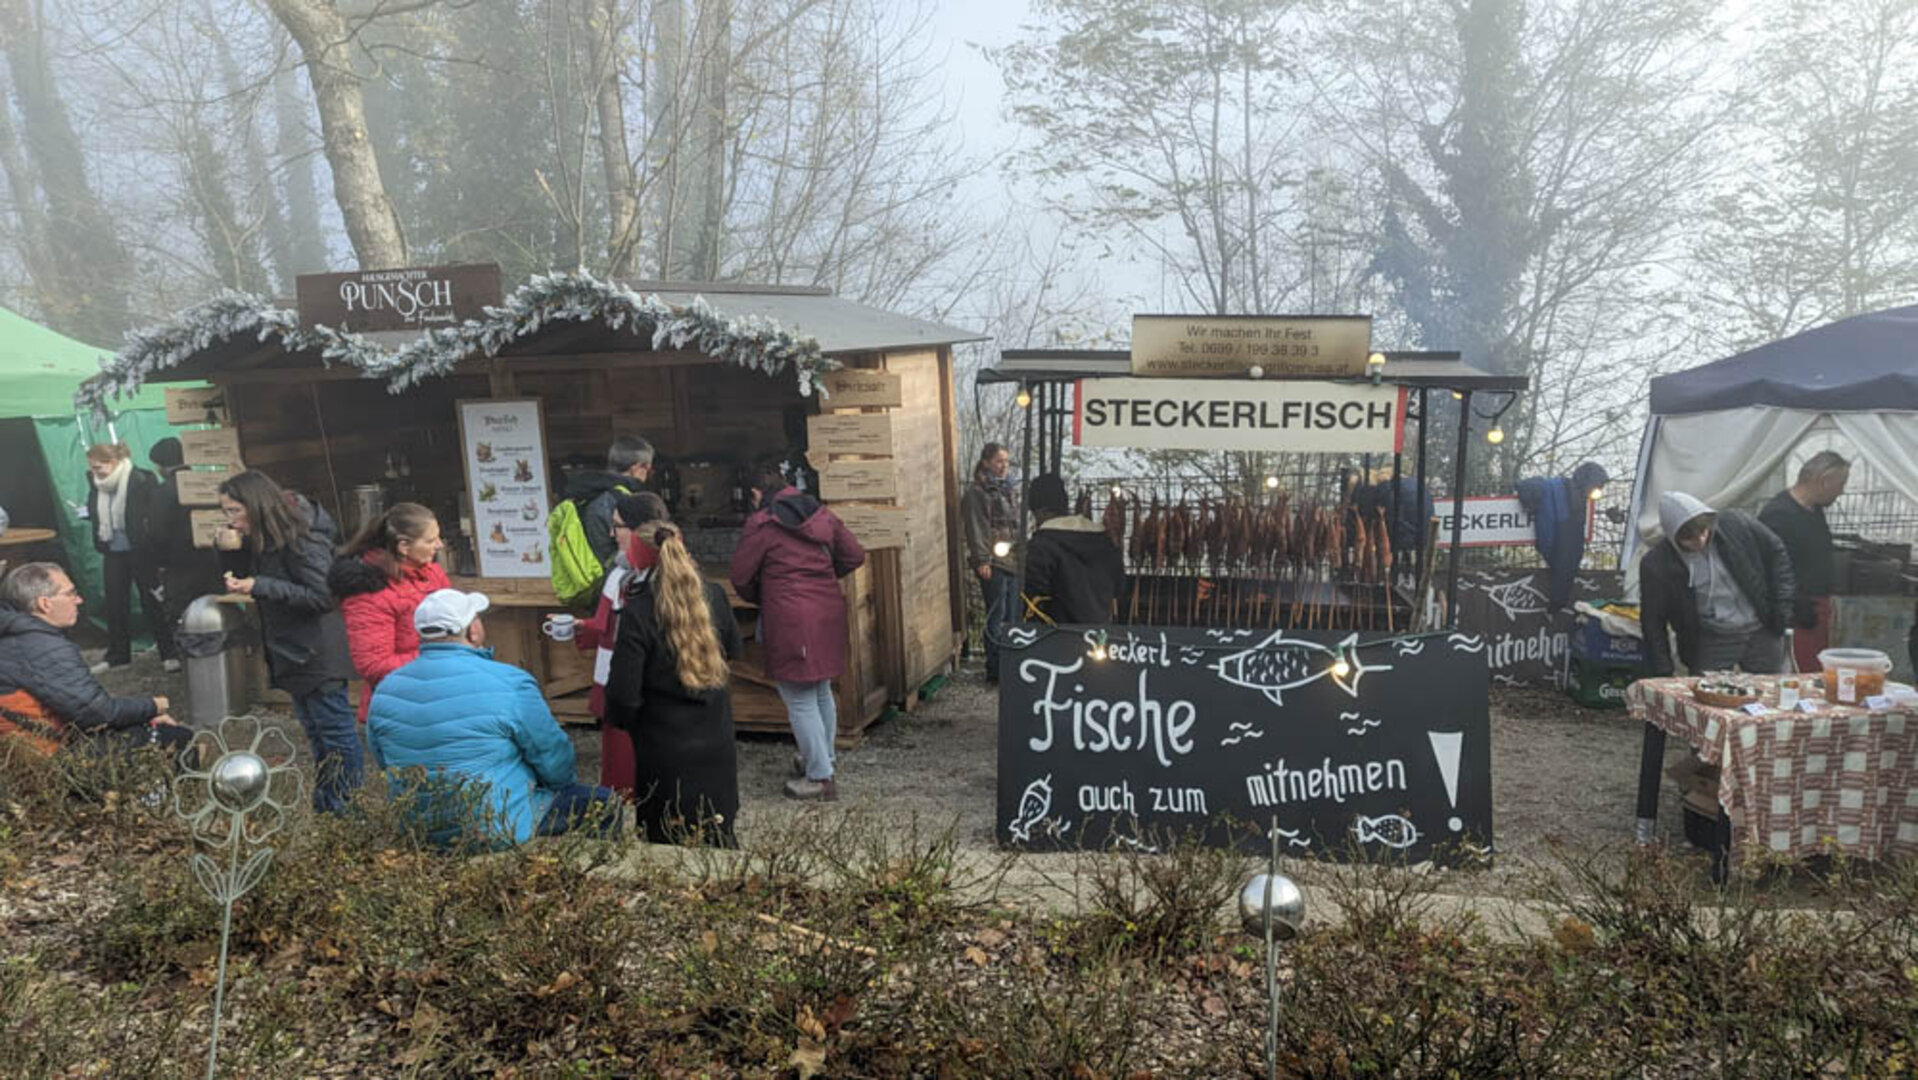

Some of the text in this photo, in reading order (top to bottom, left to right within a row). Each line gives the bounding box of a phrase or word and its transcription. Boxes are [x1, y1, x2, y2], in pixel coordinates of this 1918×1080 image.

[340, 280, 453, 317] PUNSCH
[1186, 325, 1312, 340] Wir machen Ihr Fest
[1084, 398, 1392, 430] STECKERLFISCH
[1083, 628, 1171, 668] Seckerl
[1019, 657, 1197, 767] Fische
[1078, 779, 1209, 816] auch zum
[1245, 757, 1408, 807] mitnehmen
